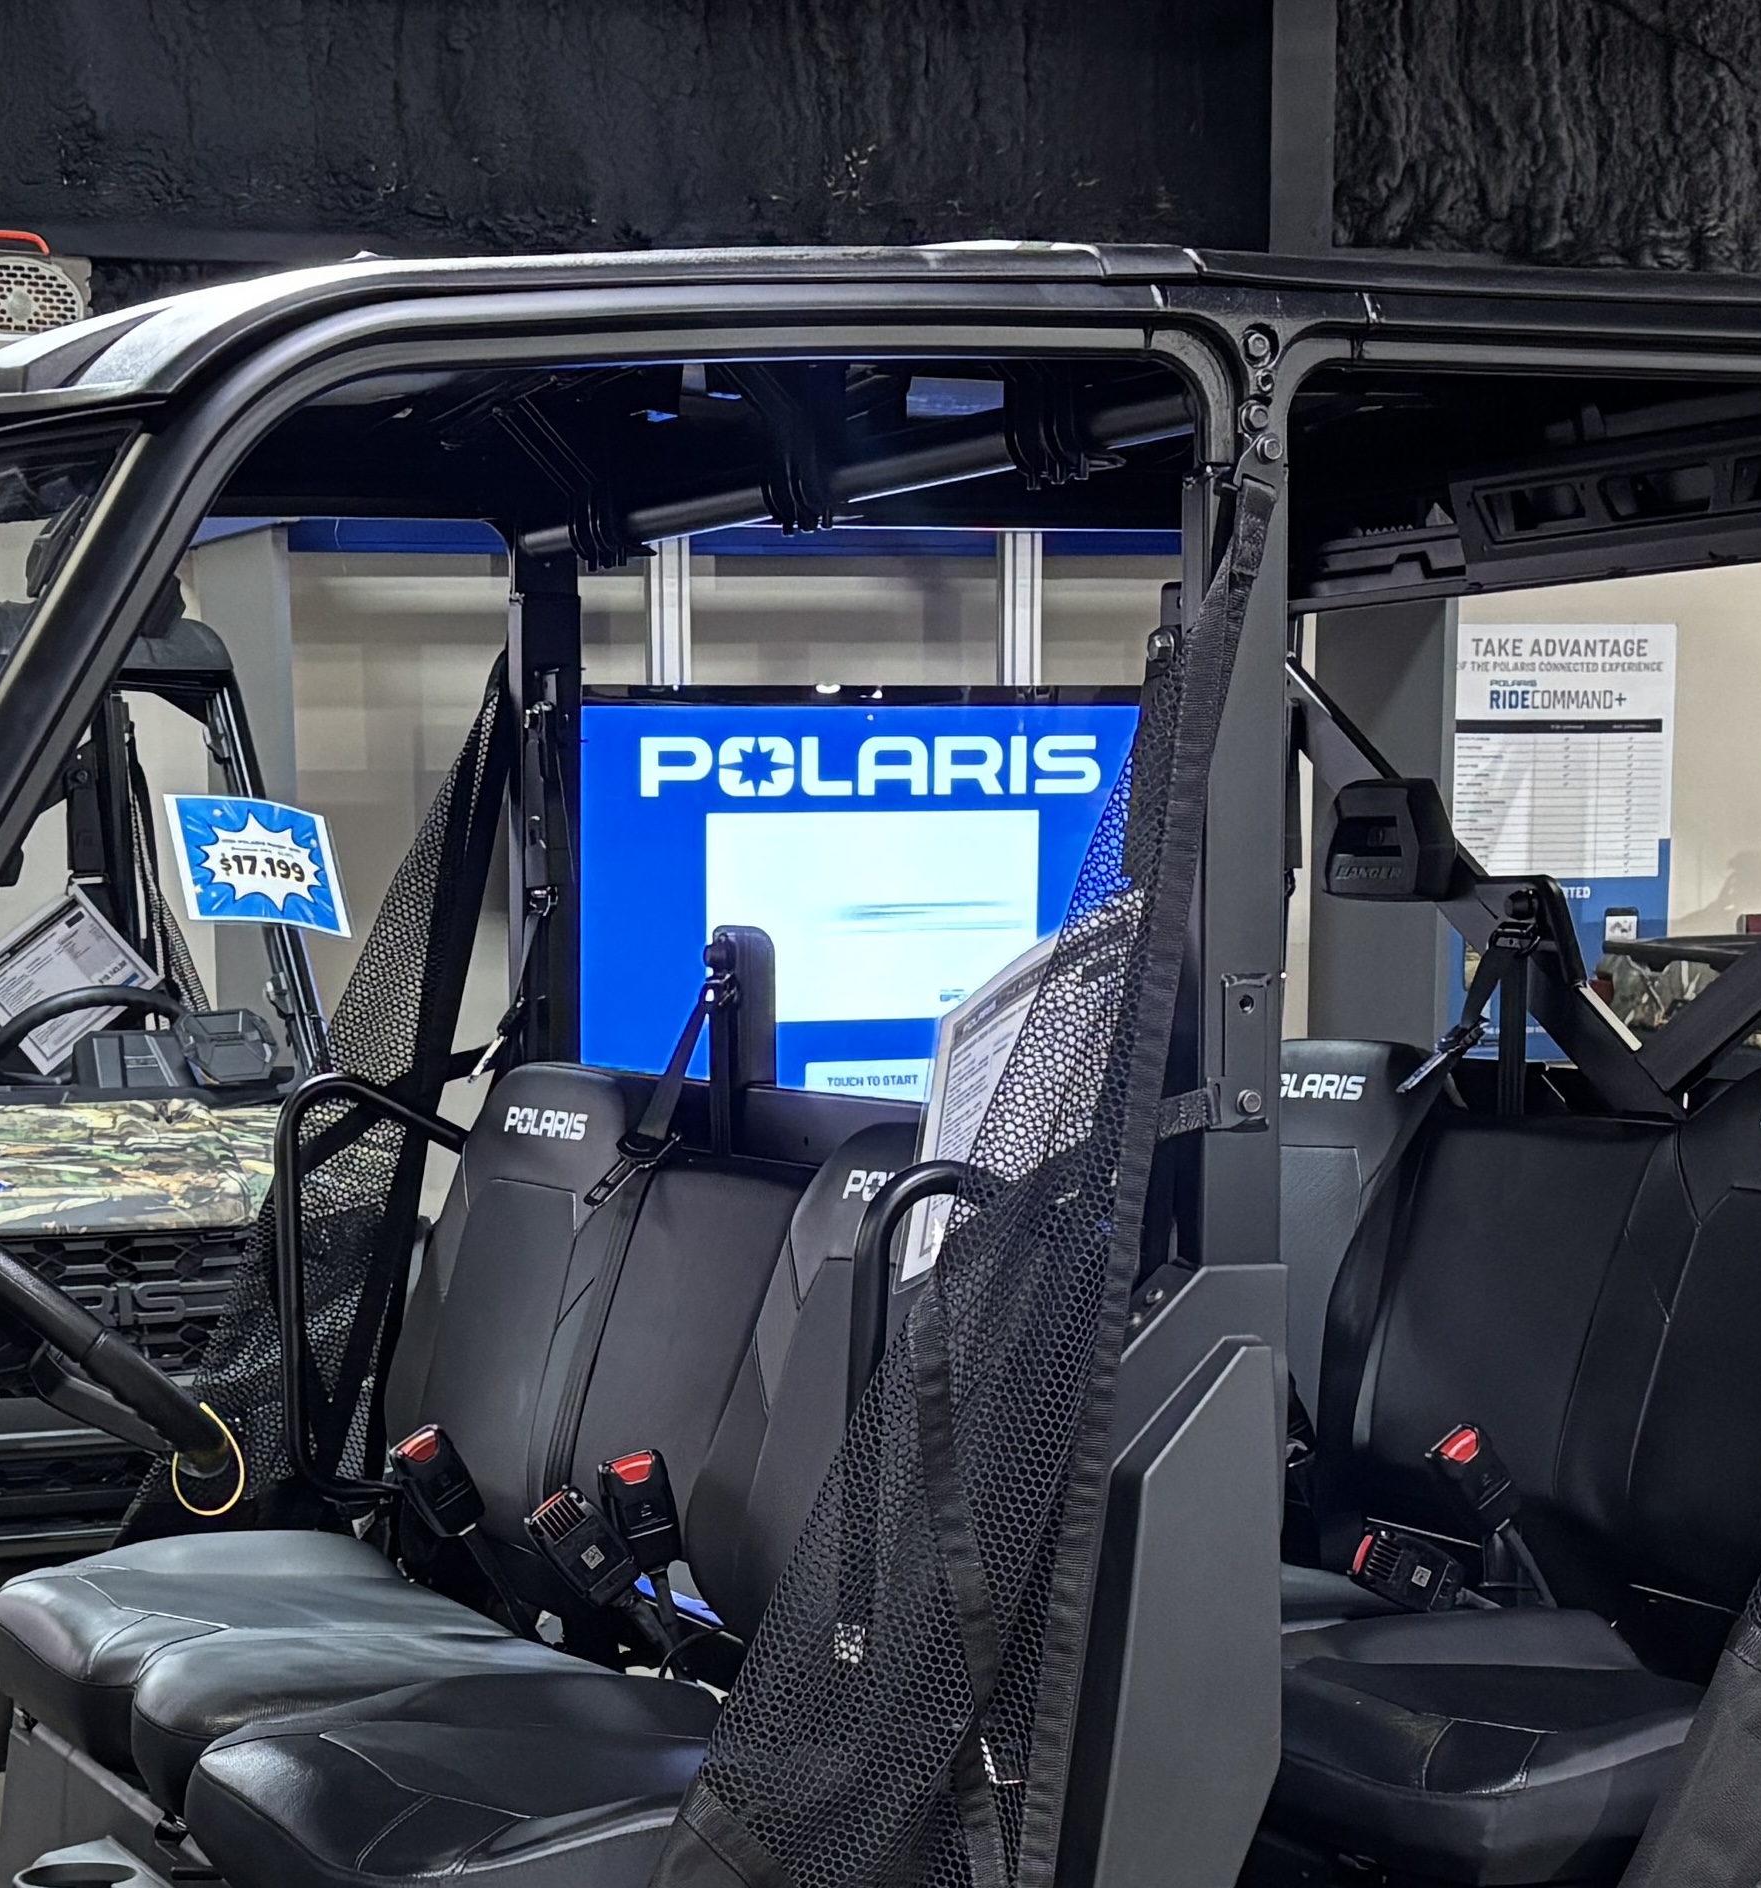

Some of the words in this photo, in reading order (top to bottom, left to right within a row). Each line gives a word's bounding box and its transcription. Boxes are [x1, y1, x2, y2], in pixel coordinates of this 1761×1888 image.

[1471, 638, 1524, 657] TAKE
[1529, 638, 1649, 658] ADVANTAGE
[1470, 661, 1490, 672] THE
[1492, 661, 1537, 672] POLARIS
[1538, 661, 1599, 673] CONNECTED
[1601, 661, 1664, 673] EXPERIENCE
[640, 735, 1101, 798] POLARIS
[220, 852, 305, 883] $17,199
[827, 1075, 863, 1087] TOUCH
[866, 1075, 880, 1086] TO
[883, 1074, 918, 1086] START
[503, 1106, 589, 1141] POLARIS
